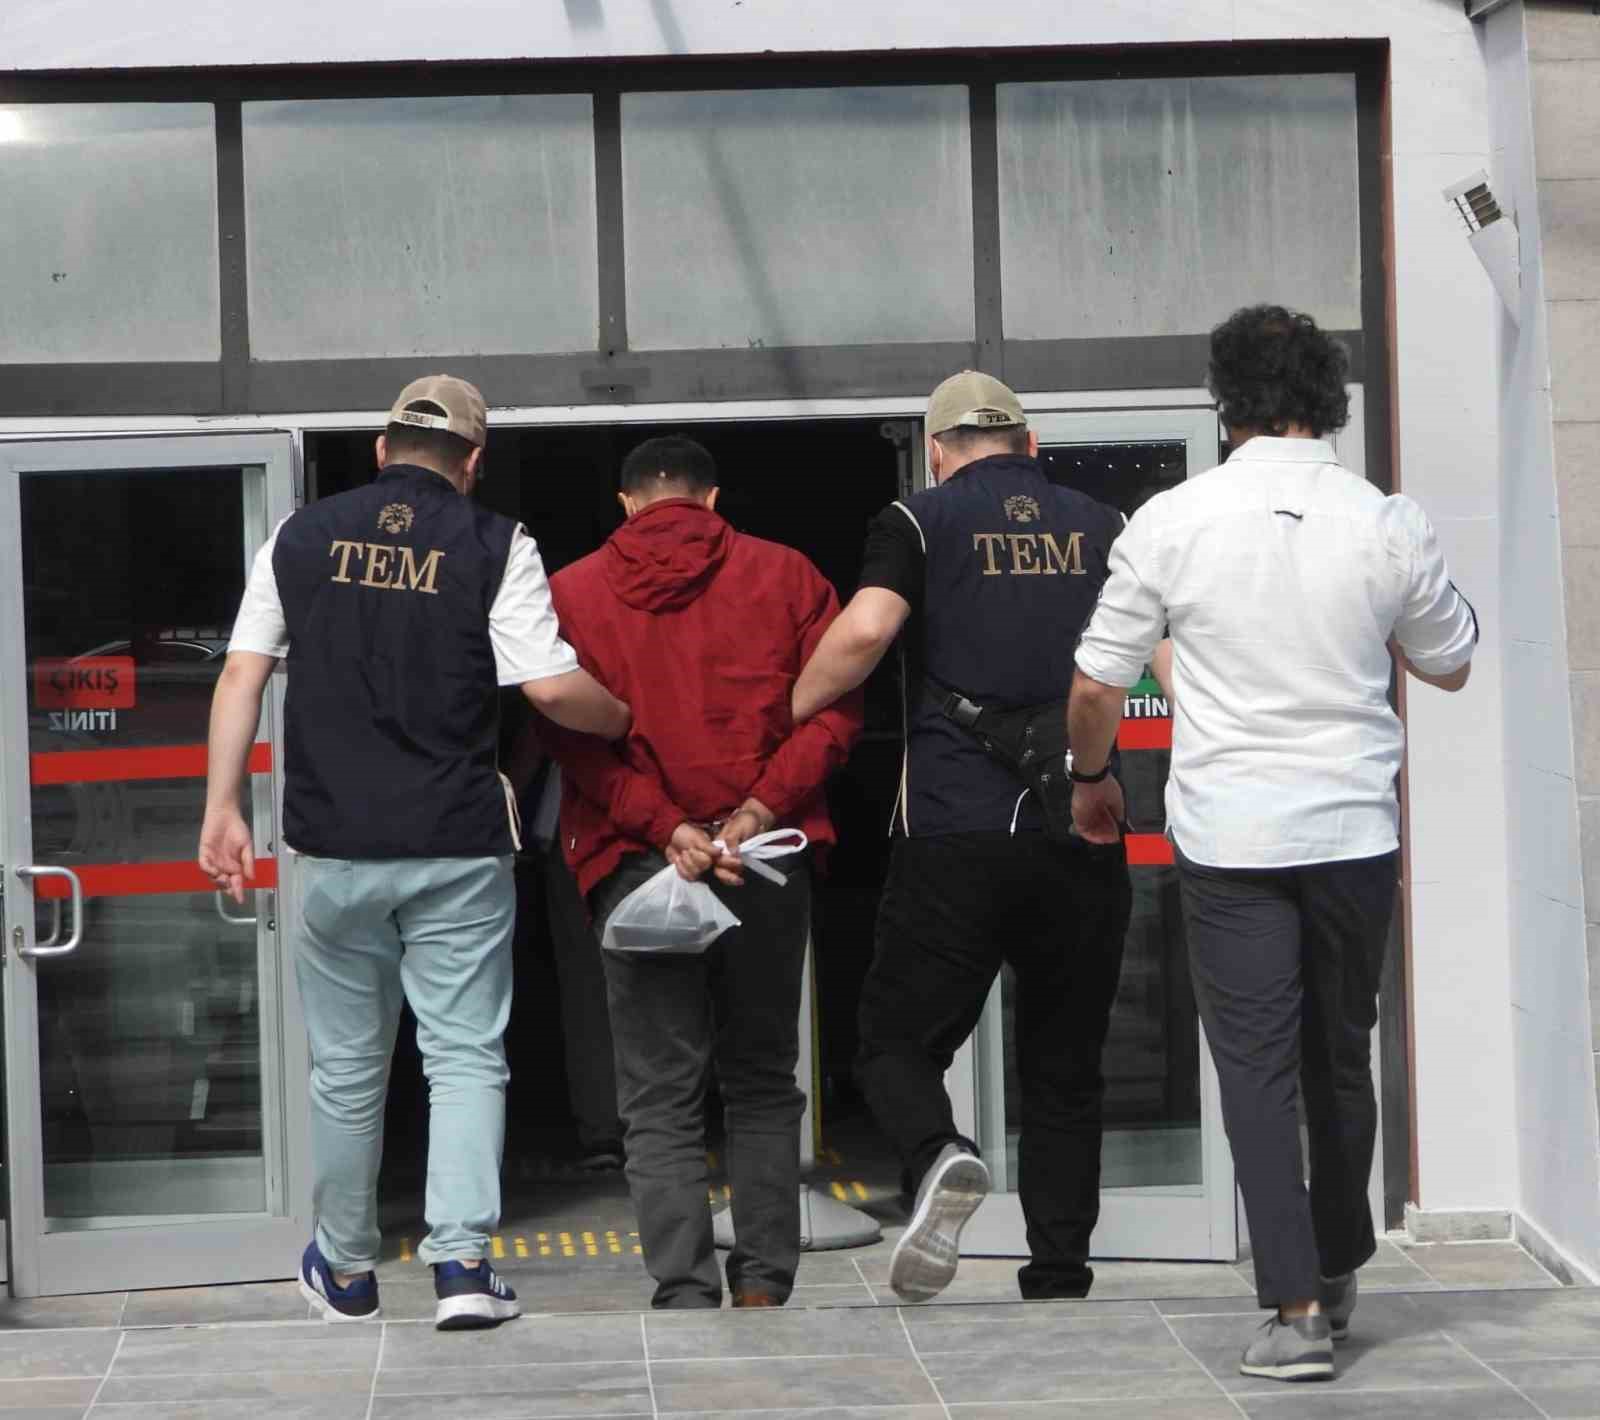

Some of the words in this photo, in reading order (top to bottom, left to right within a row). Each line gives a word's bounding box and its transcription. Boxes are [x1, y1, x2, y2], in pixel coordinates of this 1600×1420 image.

[329, 540, 446, 594] TEM
[974, 532, 1088, 575] TEM
[49, 668, 118, 695] ÇIKIŞ
[1123, 693, 1169, 718] İTİN
